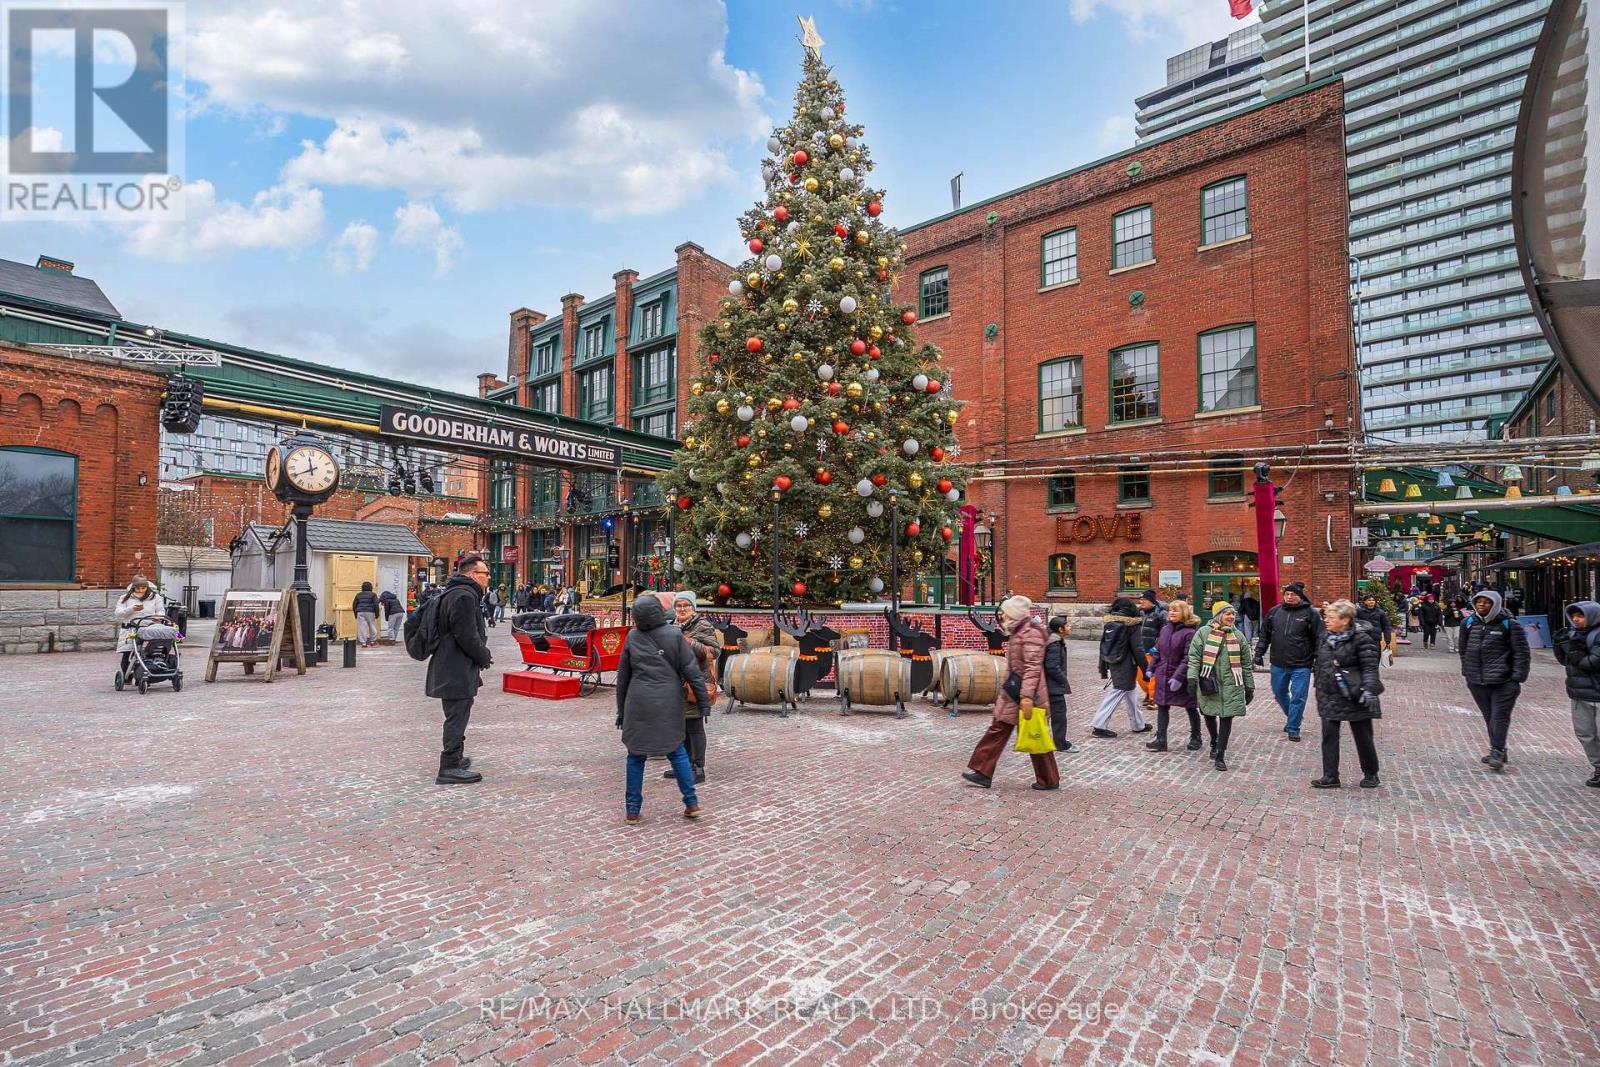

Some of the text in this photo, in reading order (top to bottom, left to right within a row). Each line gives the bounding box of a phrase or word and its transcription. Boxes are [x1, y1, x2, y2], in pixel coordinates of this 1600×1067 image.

[392, 412, 615, 461] GOODERHAM & WORTS LIMITED
[1056, 512, 1142, 543] LOVE
